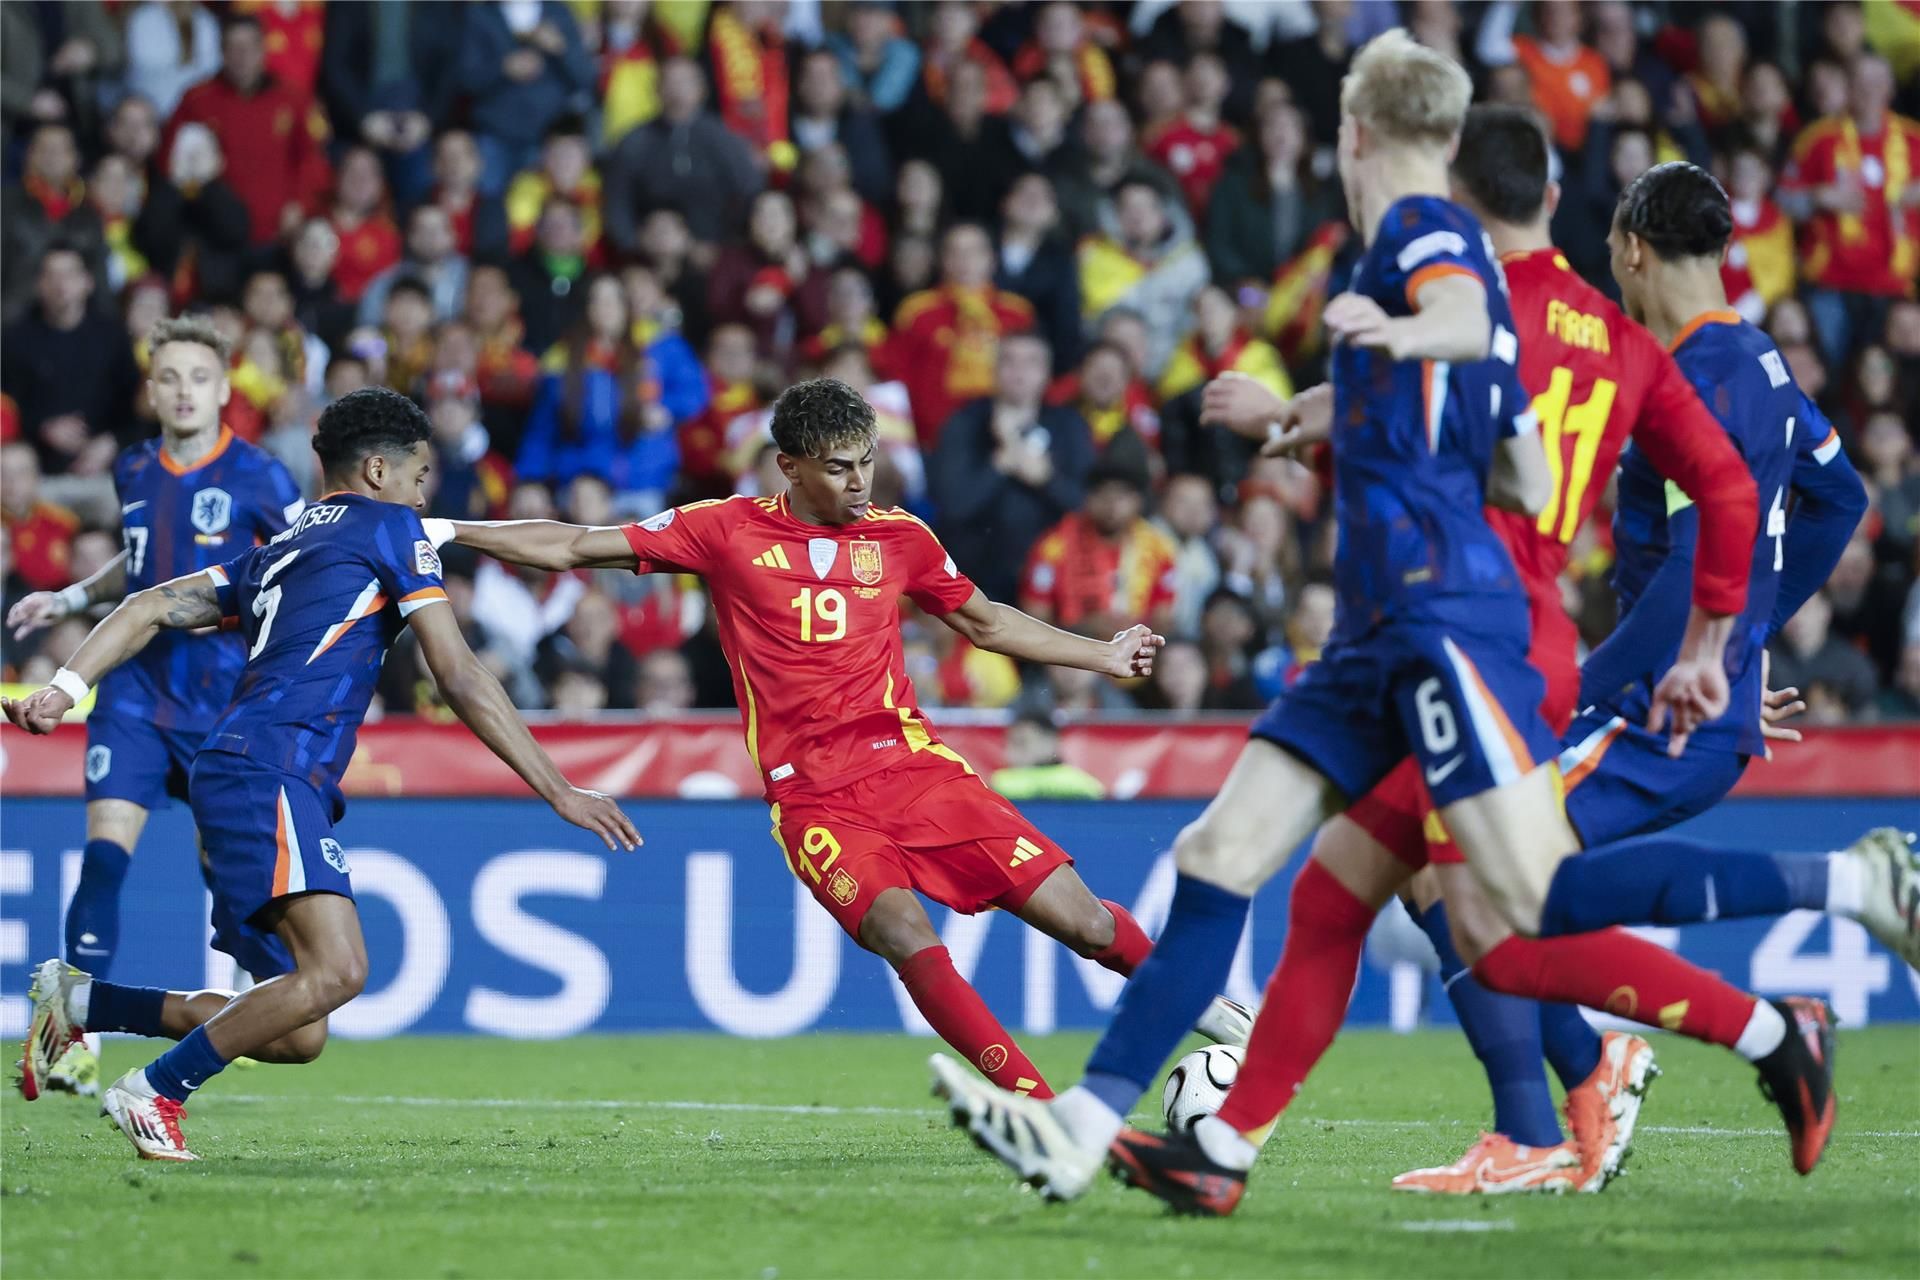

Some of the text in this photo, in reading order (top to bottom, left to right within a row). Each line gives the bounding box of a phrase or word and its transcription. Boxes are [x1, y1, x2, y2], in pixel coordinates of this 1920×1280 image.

[1532, 367, 1617, 544] 11
[249, 549, 301, 662] 5
[791, 587, 847, 642] 19
[1415, 677, 1459, 754] 6
[798, 826, 842, 885] 19
[1751, 907, 1920, 1031] 4
